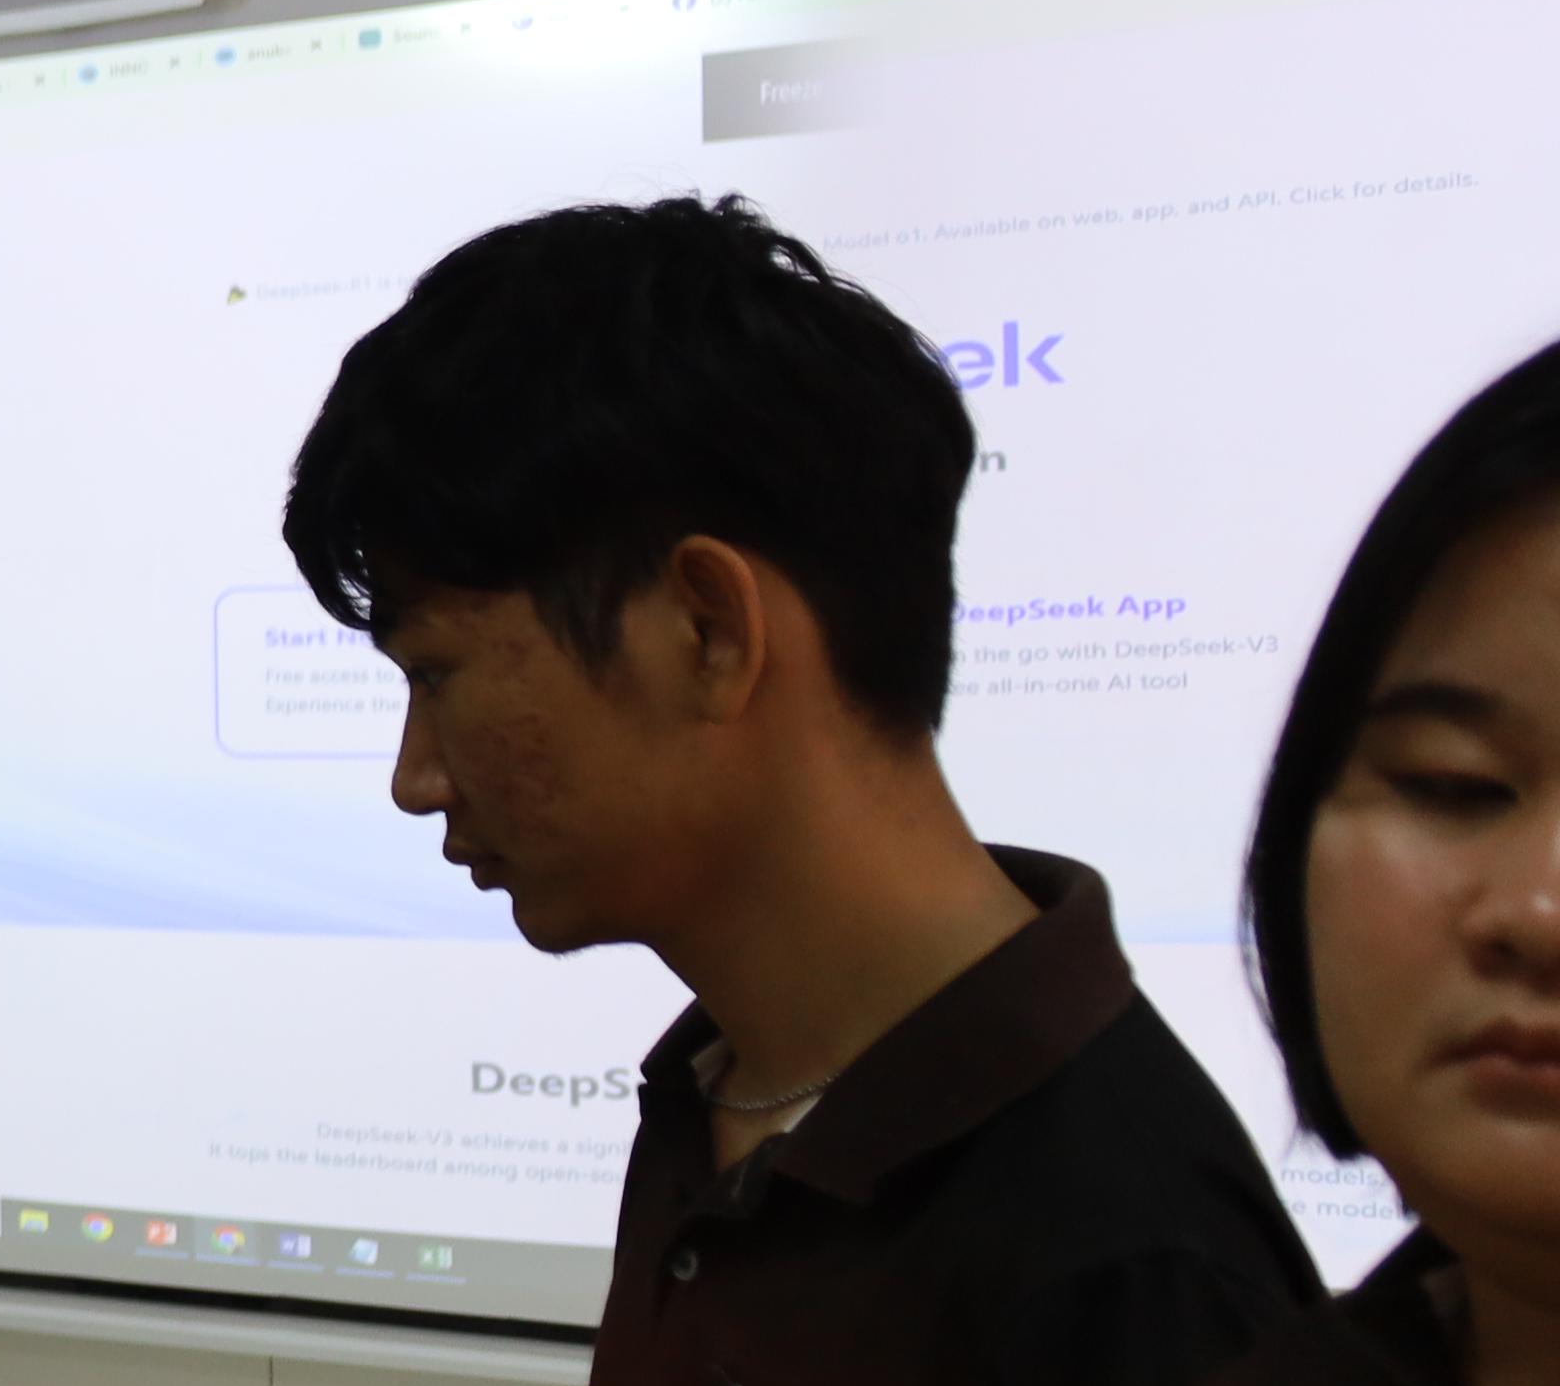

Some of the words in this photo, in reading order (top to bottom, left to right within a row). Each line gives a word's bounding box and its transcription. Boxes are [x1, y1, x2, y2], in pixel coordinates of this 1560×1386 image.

[759, 79, 826, 106] Freeze
[933, 214, 1031, 242] Available
[1037, 215, 1066, 231] on
[1187, 196, 1230, 216] and
[1289, 184, 1345, 205] Click
[1352, 180, 1387, 199] for
[1393, 171, 1479, 195] details.
[1114, 591, 1189, 627] App
[264, 628, 327, 649] Start
[972, 643, 1012, 665] the
[1017, 644, 1050, 668] go
[1056, 639, 1108, 662] with
[1114, 633, 1280, 662] DeepSeek-V3
[265, 666, 306, 685] Free
[310, 668, 369, 685] access
[374, 667, 396, 684] to
[986, 674, 1102, 697] all-in-one
[1107, 672, 1133, 692] AI
[1140, 670, 1189, 692] tool
[265, 695, 366, 717] Experience
[371, 694, 403, 714] the
[470, 1060, 636, 1109] DeepS
[315, 1121, 453, 1148] DeepSeek-V3
[459, 1128, 550, 1153] achieves
[556, 1139, 569, 1154] a
[228, 1143, 271, 1166] tops
[276, 1144, 308, 1166] the
[314, 1146, 438, 1175] leaderboard
[444, 1158, 518, 1183] among
